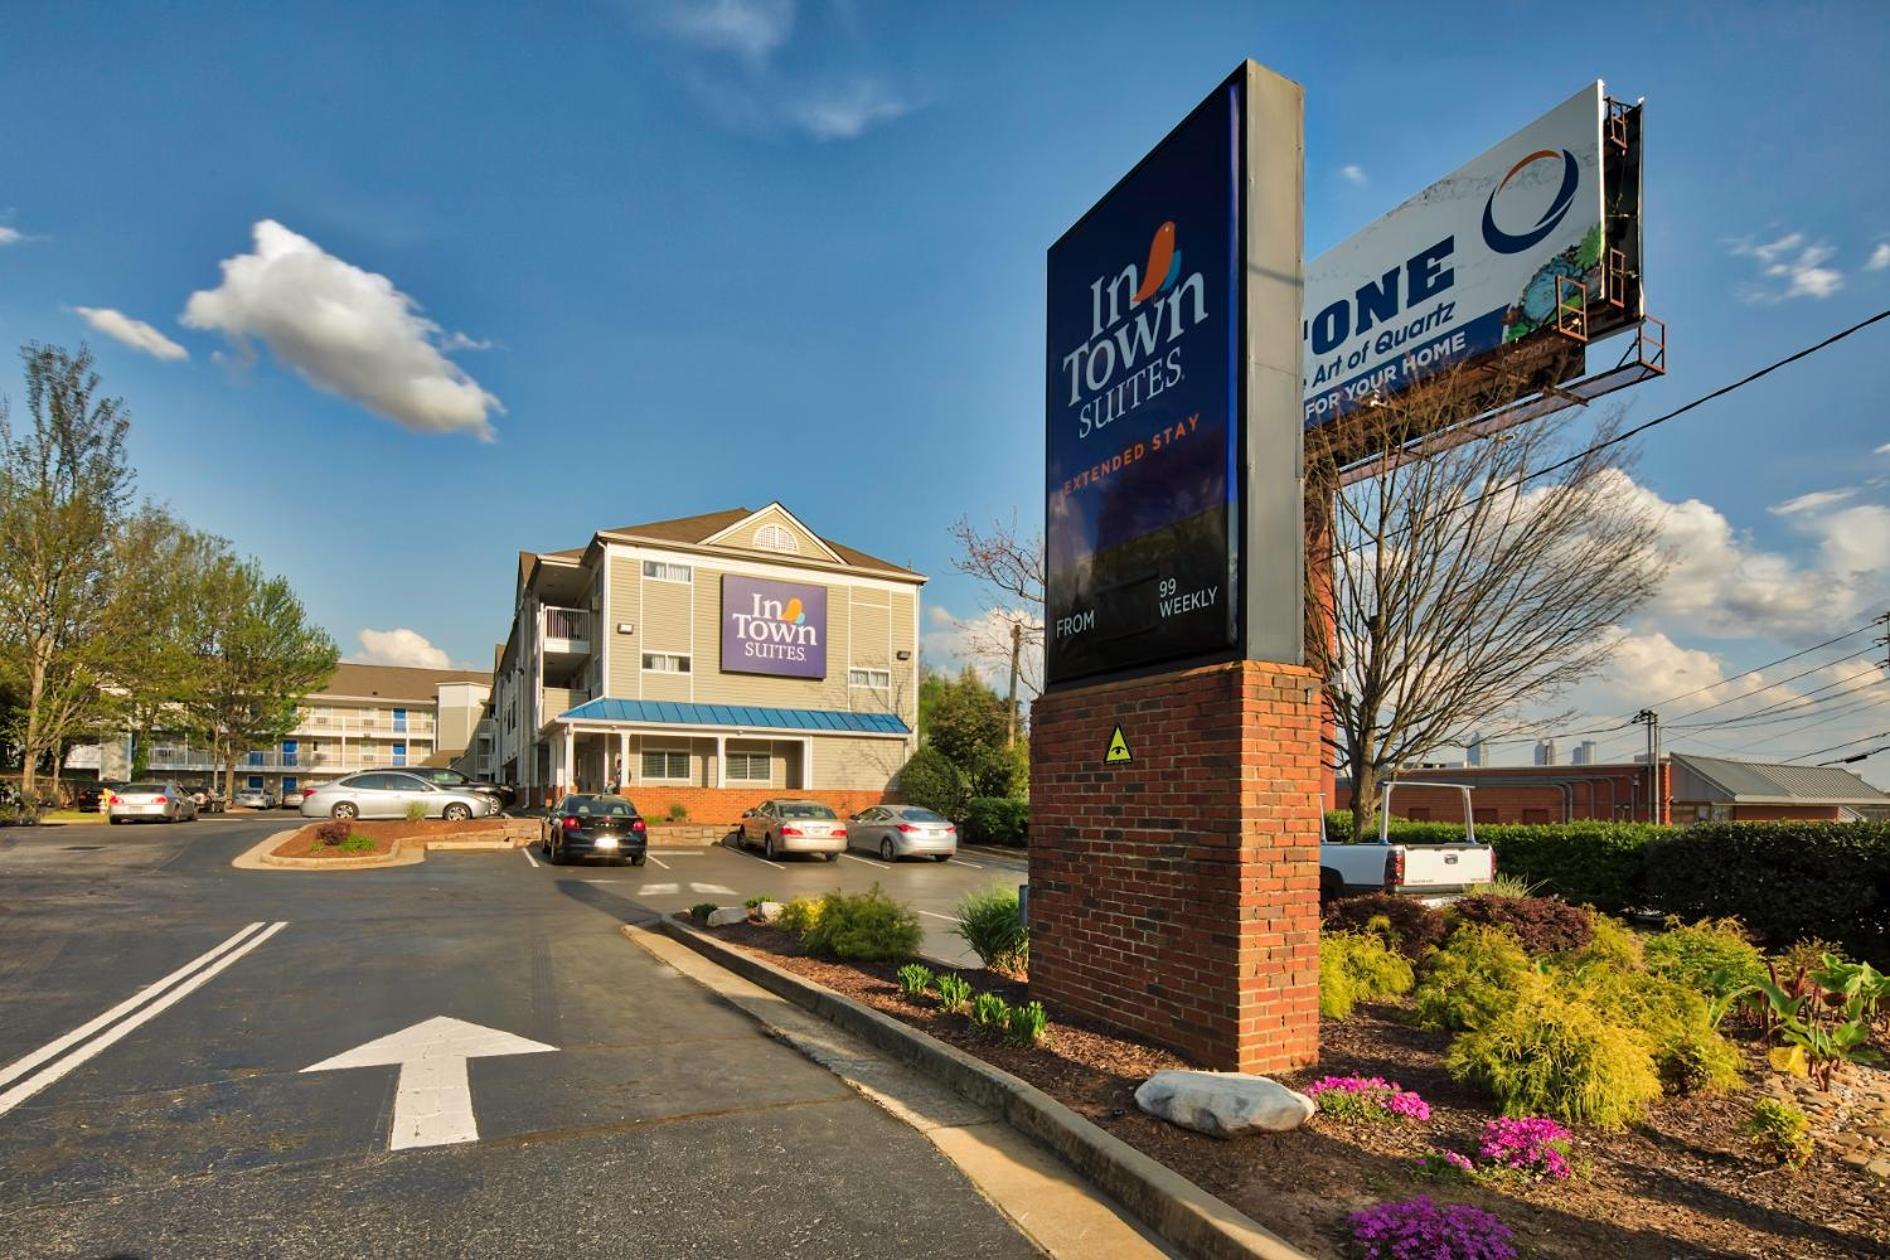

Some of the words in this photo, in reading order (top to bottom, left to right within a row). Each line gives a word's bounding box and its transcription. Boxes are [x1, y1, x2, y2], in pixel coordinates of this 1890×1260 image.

[1090, 263, 1141, 341] In
[1303, 234, 1455, 355] ONE
[1305, 392, 1340, 420] FOR
[1344, 364, 1397, 401] YOUR
[1403, 331, 1467, 371] HOME
[1312, 355, 1342, 388] Art
[1348, 340, 1369, 369] of
[1375, 301, 1456, 355] Quartz
[1078, 346, 1183, 439] SUITES
[1063, 443, 1145, 497] EXTENDED
[1152, 412, 1201, 451] STAY
[752, 592, 783, 620] In
[1056, 609, 1095, 639] FROM
[1159, 577, 1177, 598] 99
[1159, 586, 1218, 619] WEEKLY
[745, 641, 806, 662] SUITES
